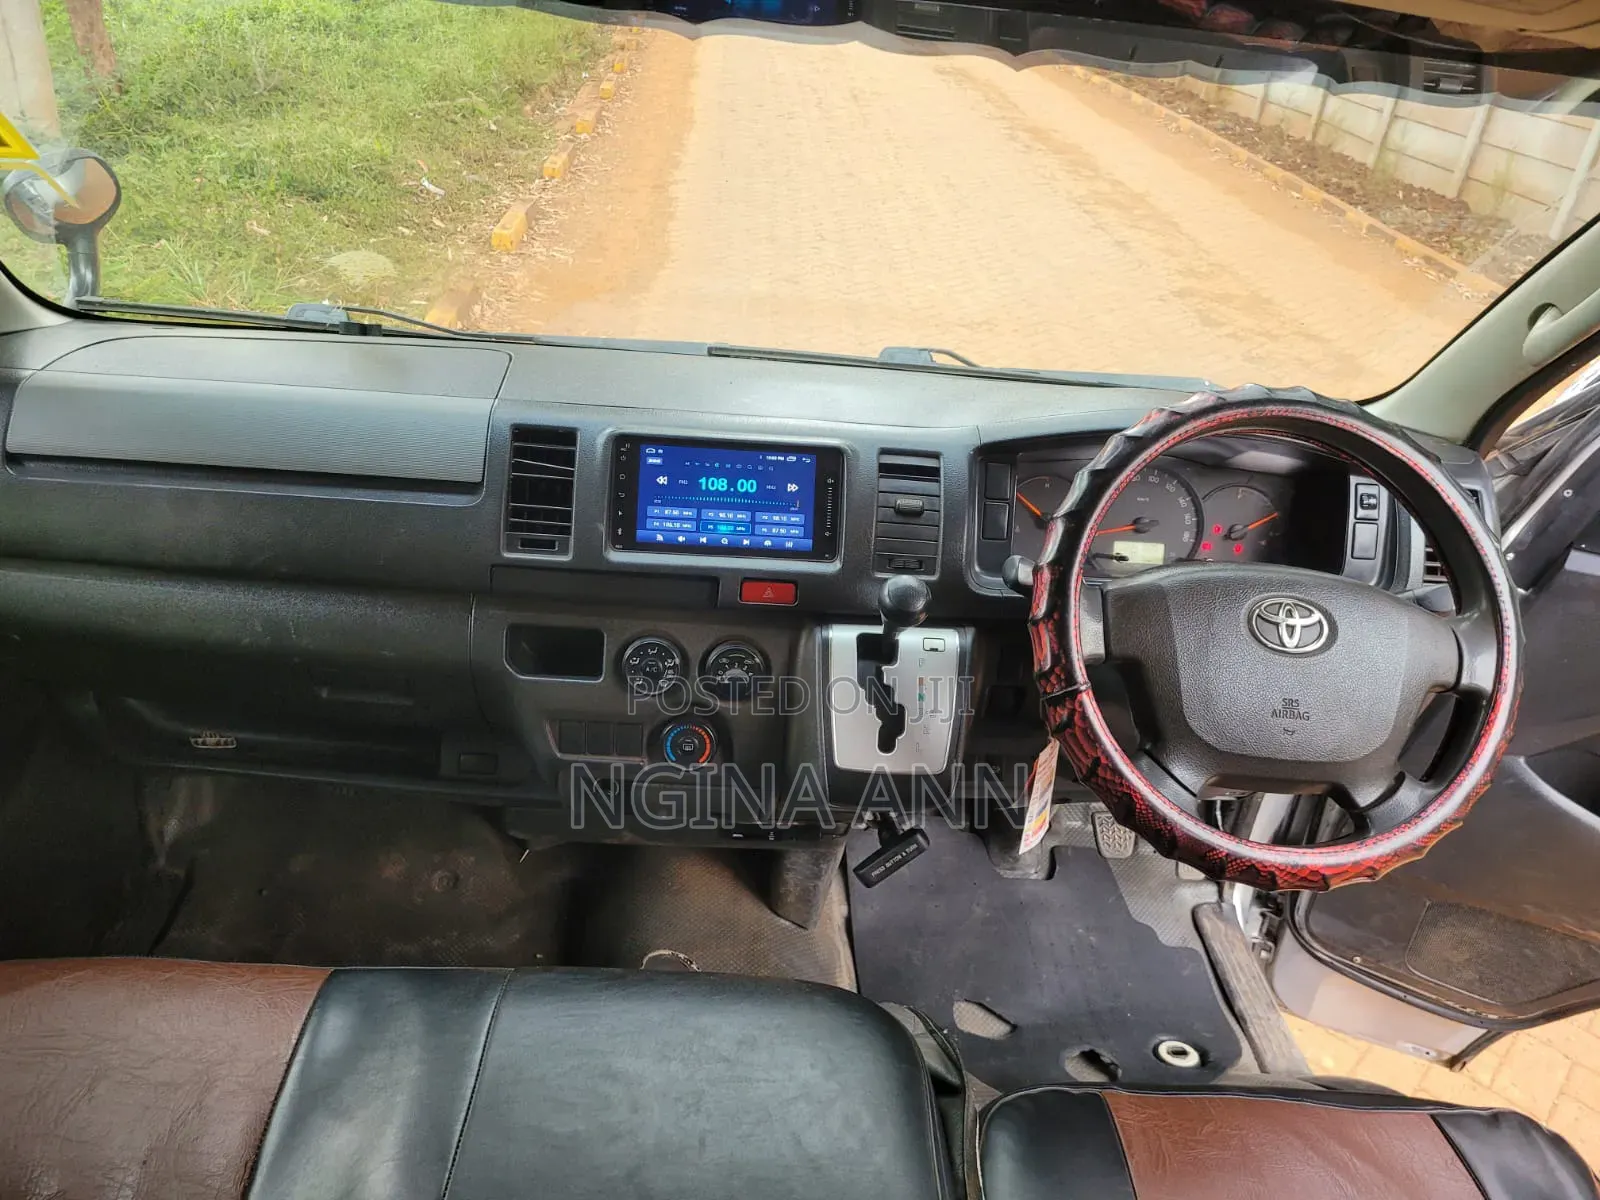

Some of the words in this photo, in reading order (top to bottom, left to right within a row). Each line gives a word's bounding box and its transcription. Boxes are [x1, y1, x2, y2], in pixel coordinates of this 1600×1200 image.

[698, 476, 757, 493] 108.00
[1281, 697, 1300, 708] SRS
[1270, 708, 1310, 721] AIRBAG
